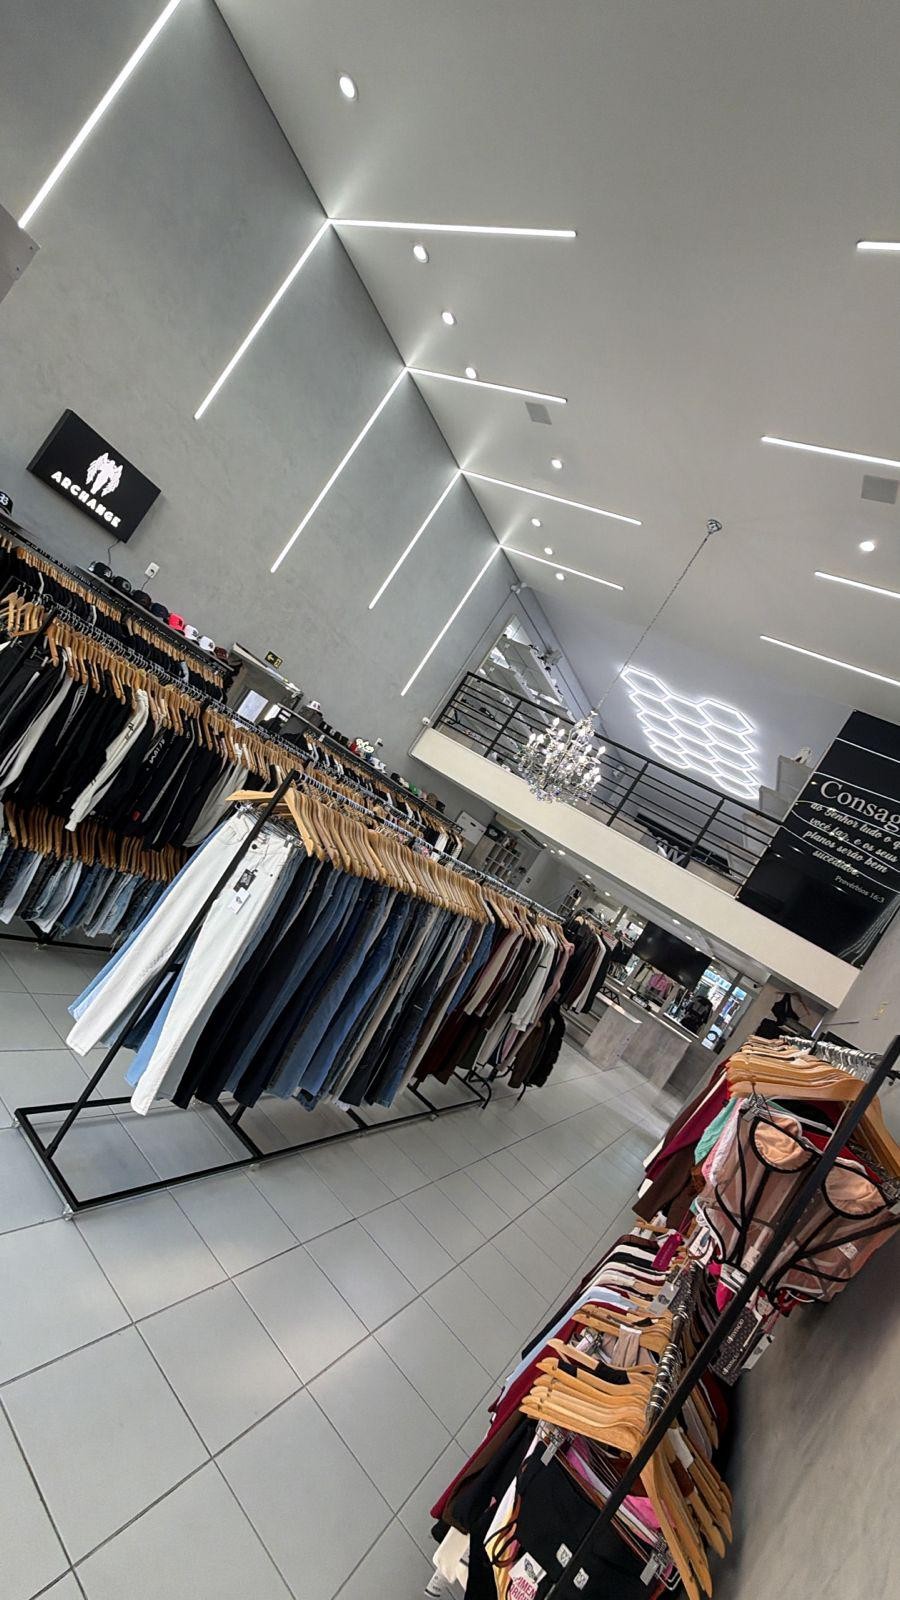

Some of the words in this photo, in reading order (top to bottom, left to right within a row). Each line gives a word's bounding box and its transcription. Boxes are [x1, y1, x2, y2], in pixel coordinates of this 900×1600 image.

[51, 471, 121, 527] ARCHANGE
[810, 802, 824, 812] ao
[824, 808, 859, 828] Senhor
[820, 780, 900, 832] Consag
[802, 830, 836, 848] planos
[863, 857, 888, 873] bem
[862, 842, 875, 852] os
[875, 848, 898, 863] seus
